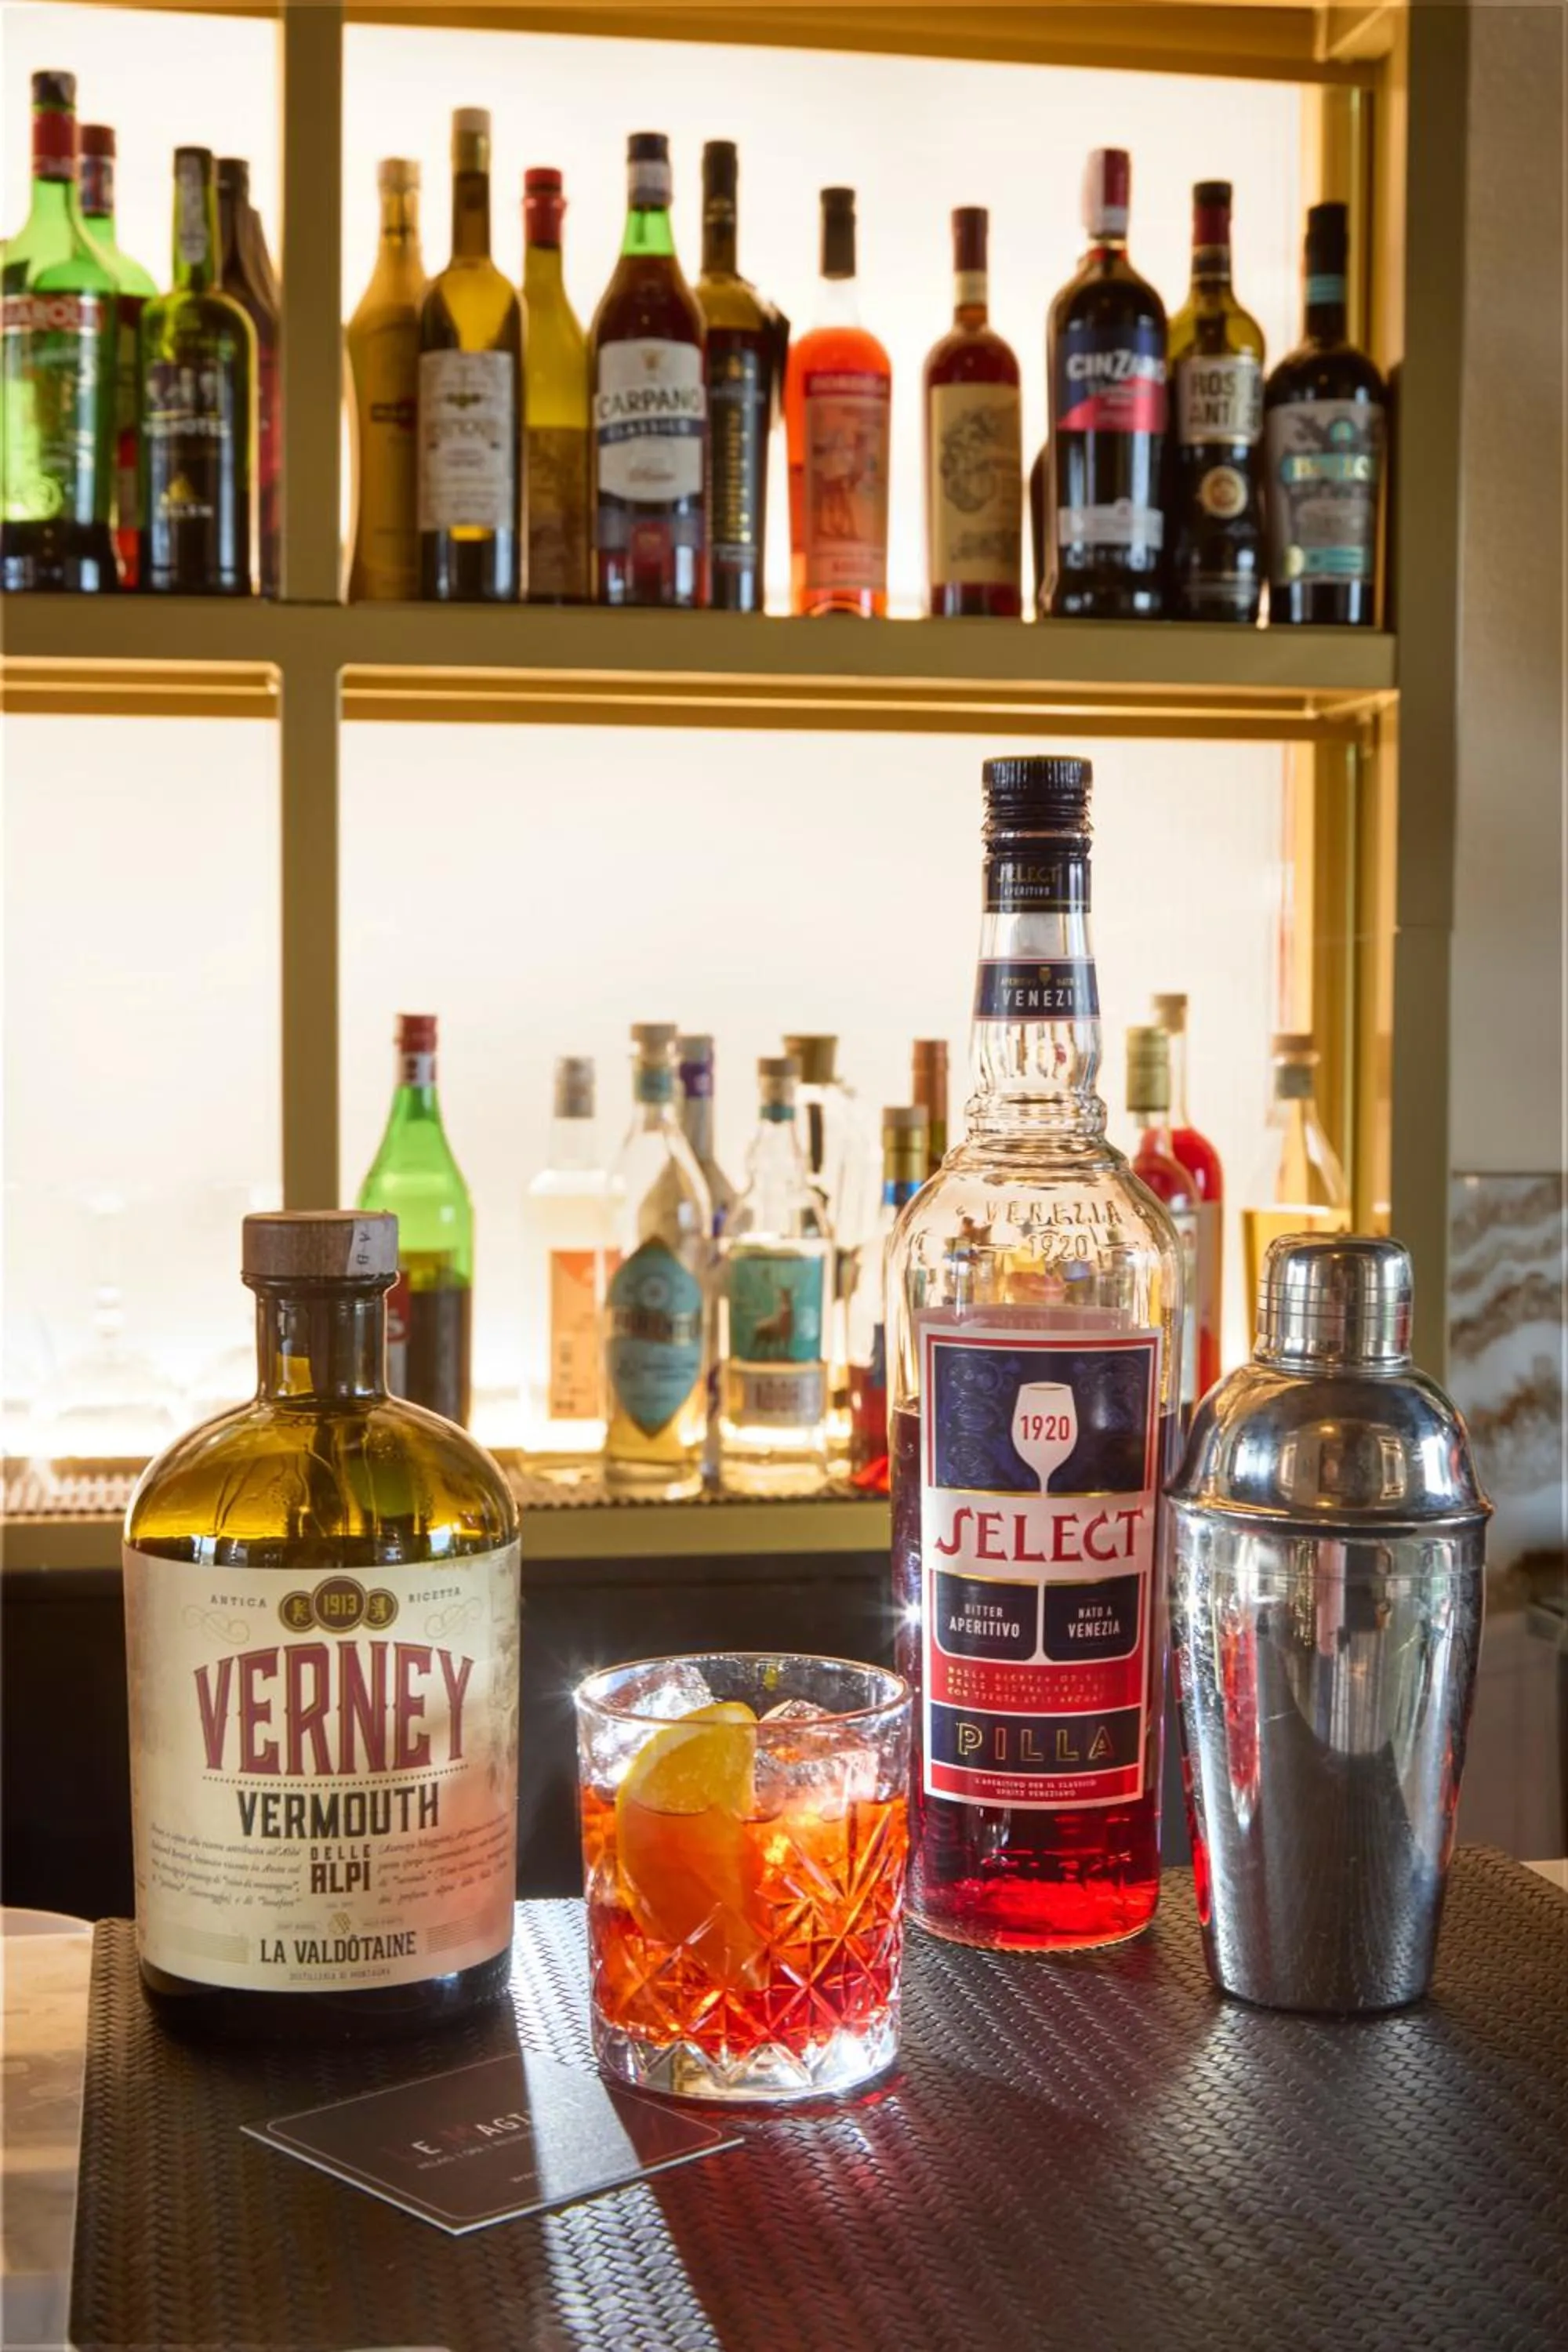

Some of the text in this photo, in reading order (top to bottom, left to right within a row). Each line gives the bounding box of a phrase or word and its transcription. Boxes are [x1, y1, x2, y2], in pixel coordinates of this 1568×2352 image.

[986, 1201, 1123, 1225] VENEZIA
[1027, 1235, 1089, 1260] 1920
[1020, 1415, 1070, 1441] 1920
[934, 1505, 1145, 1562] SELECT
[210, 1594, 267, 1608] ANTICA
[322, 1593, 358, 1616] 1913
[408, 1587, 462, 1604] RICETTA
[1078, 1606, 1113, 1619] NATO A
[949, 1616, 1020, 1638] APERITIVO
[1068, 1620, 1120, 1639] VENEZIA
[194, 1641, 474, 1776] VERNEY
[957, 1723, 1113, 1761] PILLA
[237, 1782, 439, 1839] VERMOUTH
[310, 1844, 371, 1861] DELLE
[310, 1860, 371, 1894] ALPI
[260, 1931, 417, 1965] LA VALDÔTAINE
